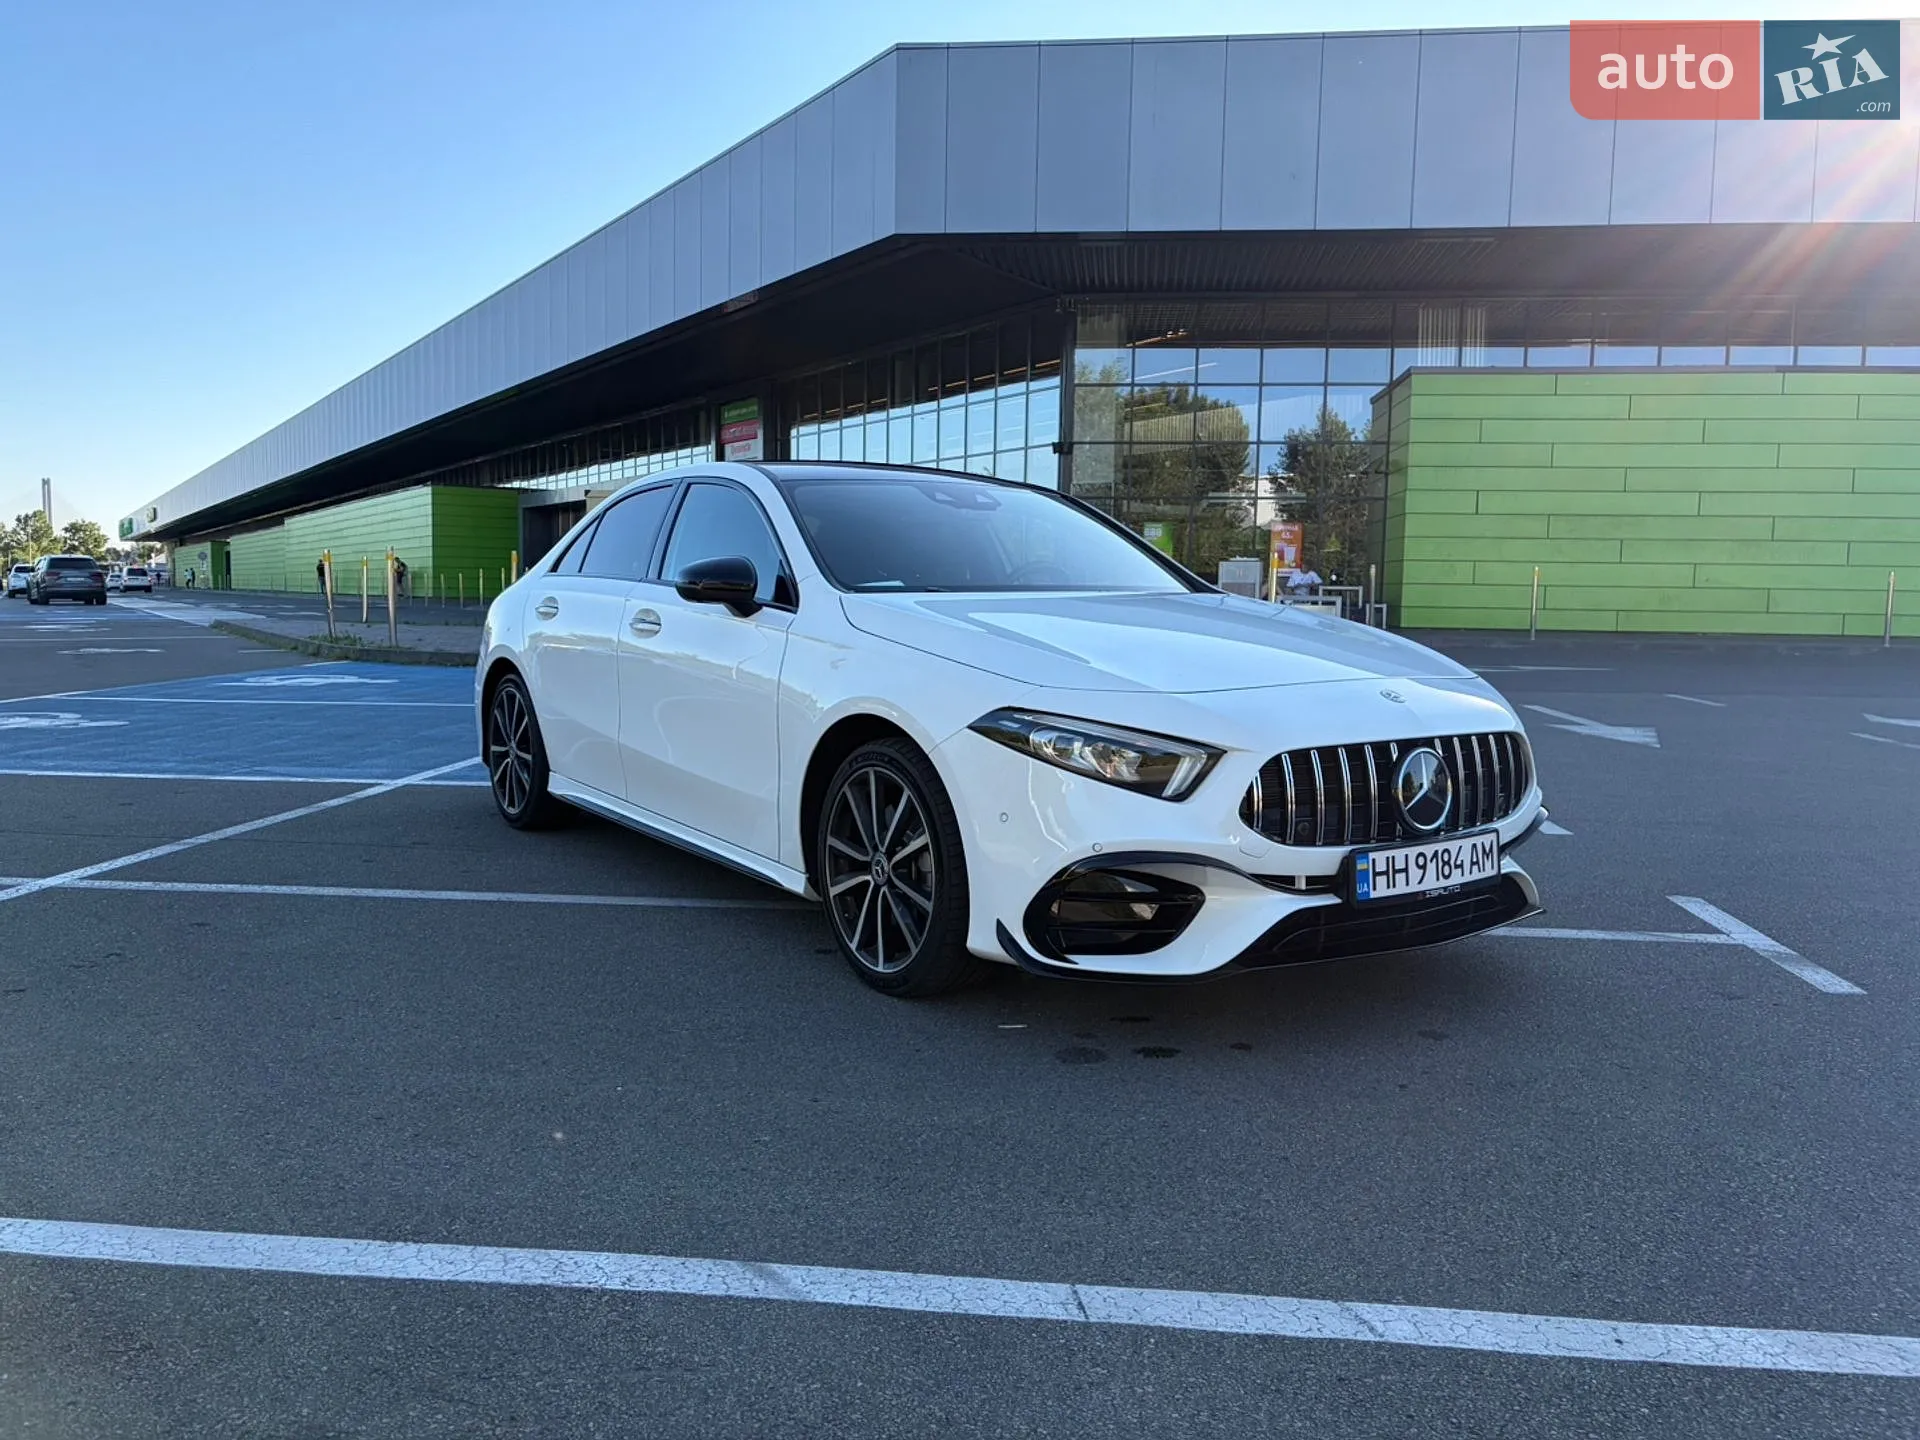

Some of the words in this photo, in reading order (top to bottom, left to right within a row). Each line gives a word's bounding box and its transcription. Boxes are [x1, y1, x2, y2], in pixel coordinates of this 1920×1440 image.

[1372, 854, 1409, 892] HH
[1415, 846, 1465, 885] 9184
[1469, 839, 1495, 876] AM
[1356, 882, 1369, 894] UA
